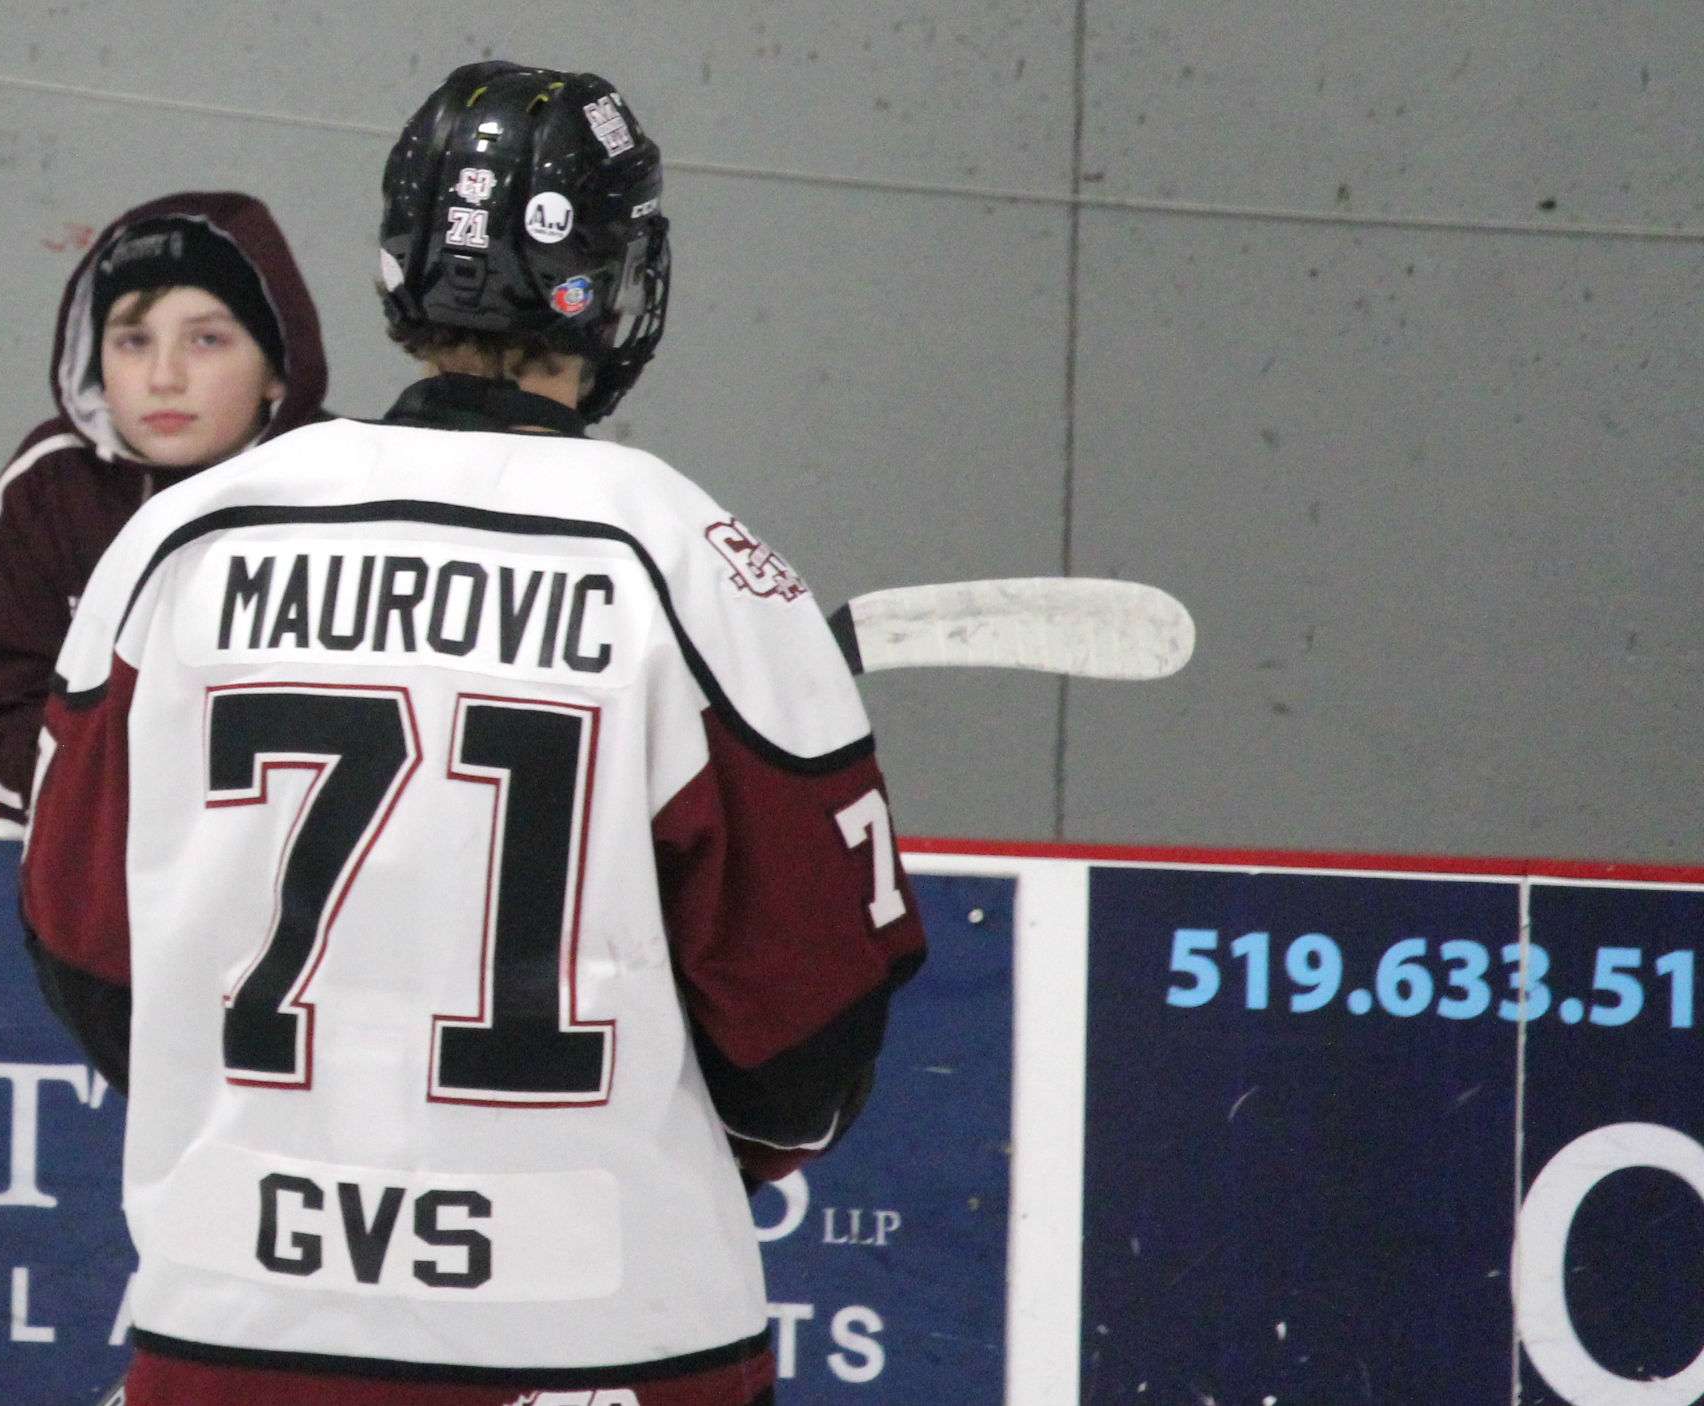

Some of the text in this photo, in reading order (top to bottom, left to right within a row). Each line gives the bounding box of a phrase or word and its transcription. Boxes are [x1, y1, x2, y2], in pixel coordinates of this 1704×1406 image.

[446, 206, 490, 249] 71
[217, 555, 615, 673] MAUROVIC
[203, 681, 617, 1107] 71
[1166, 927, 1694, 1030] 519.633.51
[255, 1172, 494, 1290] GVS
[822, 1206, 902, 1247] LLP
